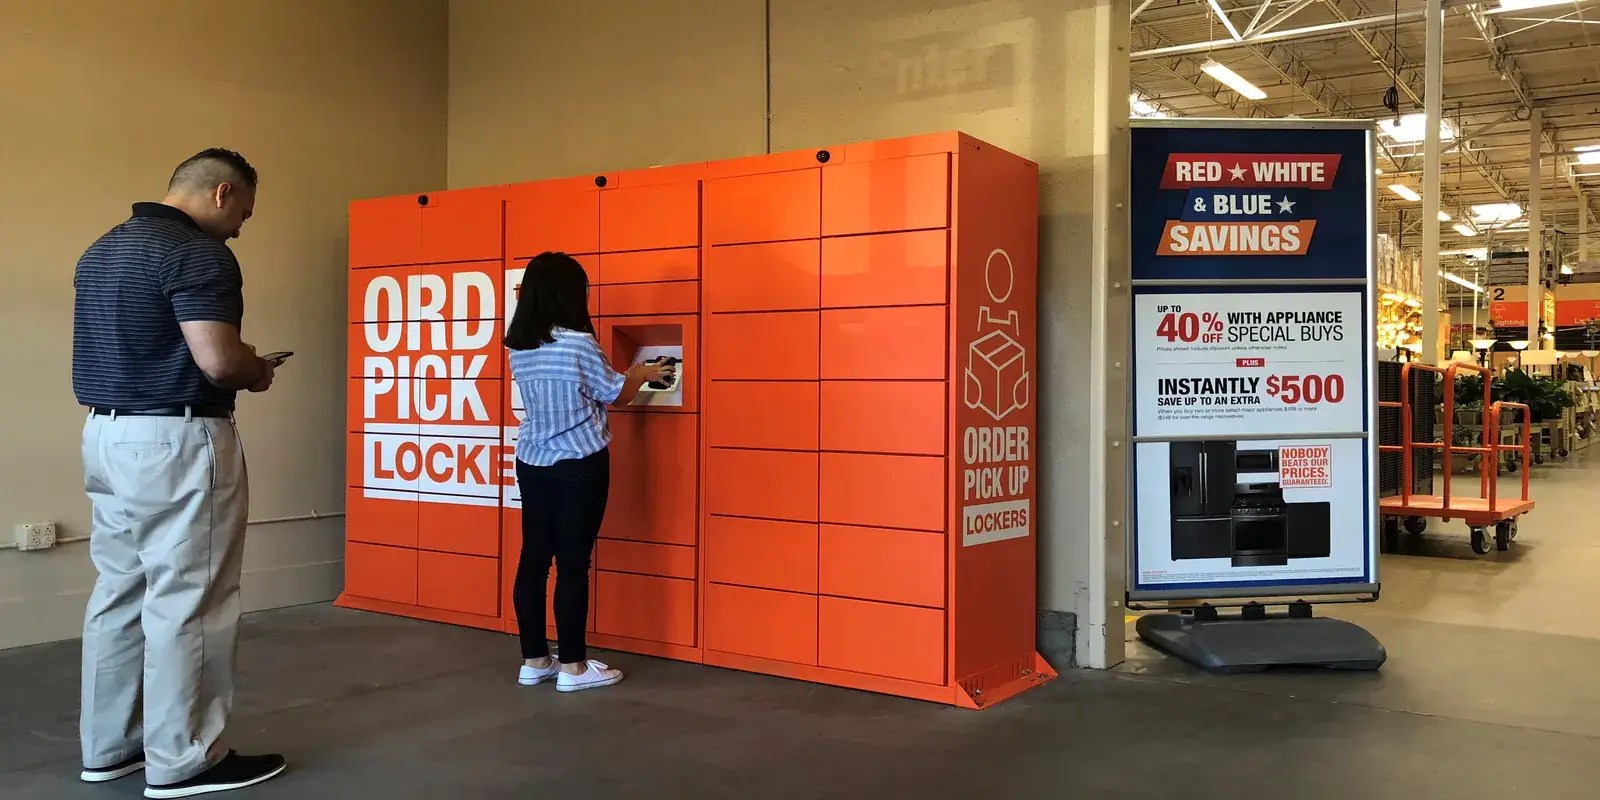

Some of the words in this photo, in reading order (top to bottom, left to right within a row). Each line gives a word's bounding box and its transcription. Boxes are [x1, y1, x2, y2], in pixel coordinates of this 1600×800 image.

[1176, 161, 1222, 182] RED
[1252, 161, 1325, 182] WHITE
[1193, 197, 1207, 212] &
[1213, 194, 1272, 215] BLUE
[1169, 224, 1301, 252] SAVINGS
[1493, 288, 1505, 301] 2
[364, 268, 525, 353] ORD
[1157, 305, 1168, 313] UP
[1171, 305, 1181, 313] TO
[1227, 311, 1262, 325] WITH
[1266, 311, 1343, 324] APPLIANCE
[1156, 312, 1224, 343] 40%
[1227, 325, 1296, 343] SPECIAL
[1300, 325, 1344, 342] BUYS
[1202, 333, 1223, 344] OFF
[364, 354, 490, 421] PICK
[1158, 377, 1260, 396] INSTANTLY
[1266, 374, 1345, 404] $500
[1157, 397, 1182, 406] SAVE
[1184, 397, 1197, 406] UP
[1200, 396, 1212, 405] TO
[1214, 396, 1228, 405] AN
[1230, 395, 1261, 405] EXTRA
[963, 426, 1029, 465] ORDER
[1281, 447, 1329, 459] NOBODY
[373, 440, 516, 486] LOCKE
[1282, 459, 1309, 467] BEATS
[1310, 458, 1328, 467] OUR
[1282, 467, 1329, 478] PRICES.
[964, 466, 1004, 501] PICK
[1008, 465, 1029, 497] UP
[966, 508, 1027, 536] LOCKERS
